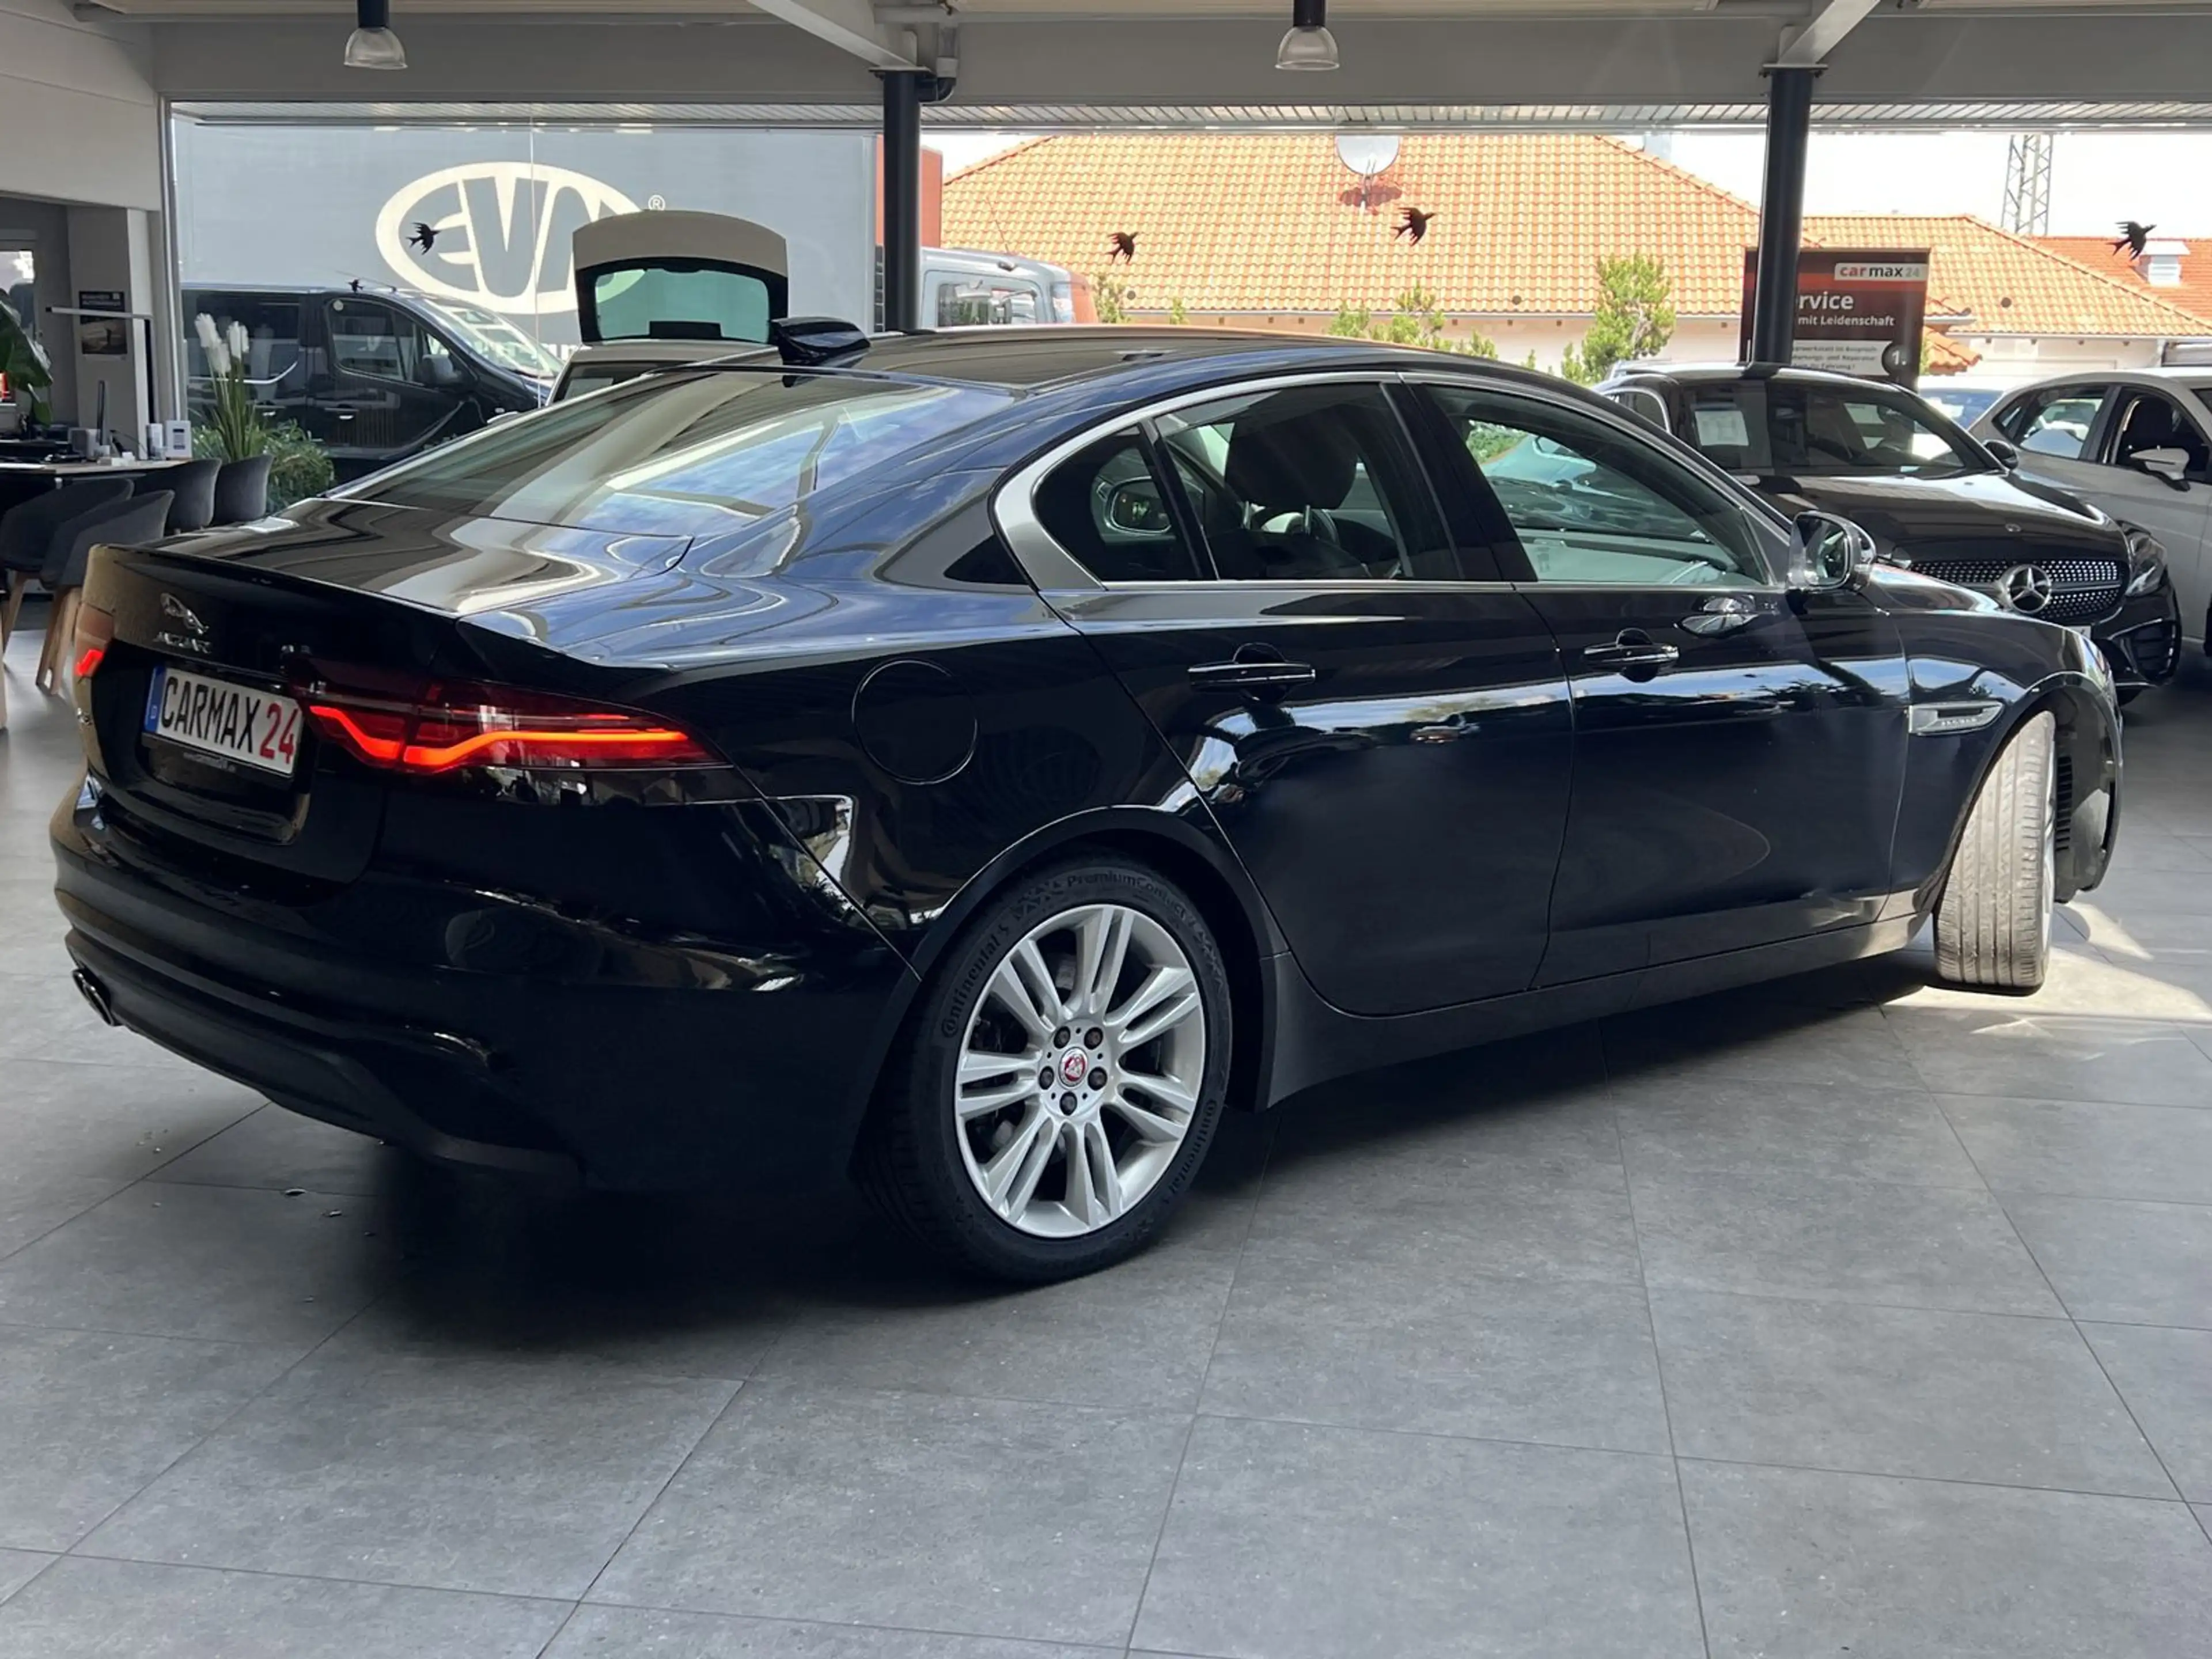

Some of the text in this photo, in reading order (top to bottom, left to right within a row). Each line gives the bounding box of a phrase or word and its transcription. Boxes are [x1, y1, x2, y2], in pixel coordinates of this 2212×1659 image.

[1798, 291, 1854, 310] rvice
[1798, 315, 1896, 327] mit Leidenschaft
